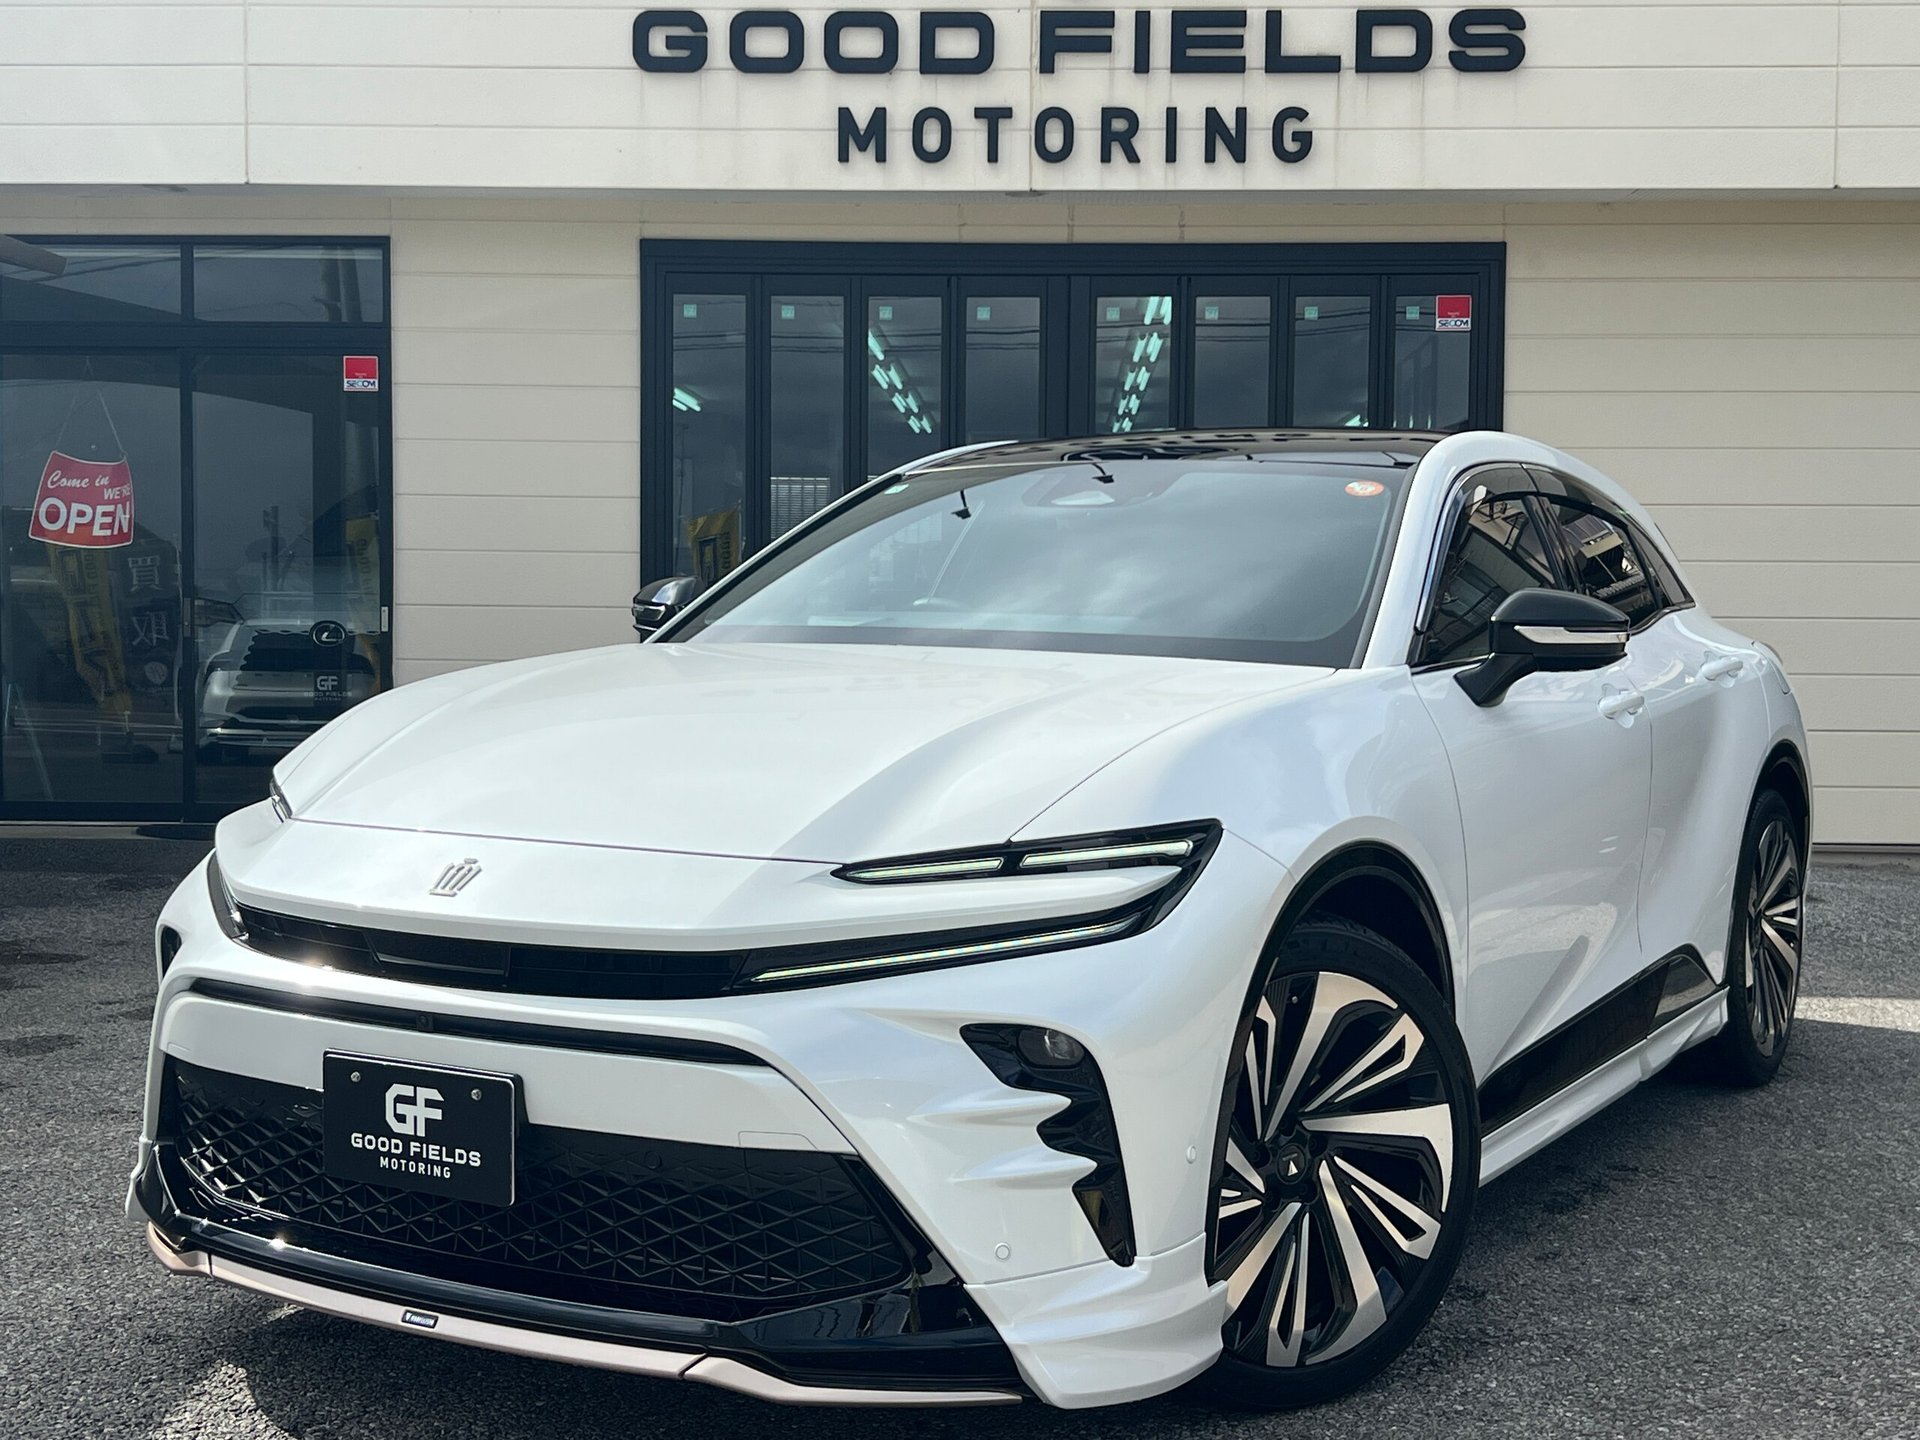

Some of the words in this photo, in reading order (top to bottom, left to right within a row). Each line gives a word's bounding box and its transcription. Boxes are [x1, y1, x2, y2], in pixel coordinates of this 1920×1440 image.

[633, 9, 995, 76] GOOD
[1038, 8, 1527, 75] FIELDS
[837, 106, 1313, 164] MOTORING
[1439, 319, 1469, 328] SECOM
[346, 380, 376, 388] SECOM
[47, 470, 90, 489] Come
[94, 474, 111, 487] in
[38, 497, 131, 537] OPEN
[316, 675, 338, 691] GF
[385, 1083, 445, 1137] GF
[350, 1132, 403, 1155] GOOD
[409, 1141, 482, 1167] FIELDS
[379, 1156, 452, 1179] MOTORING
